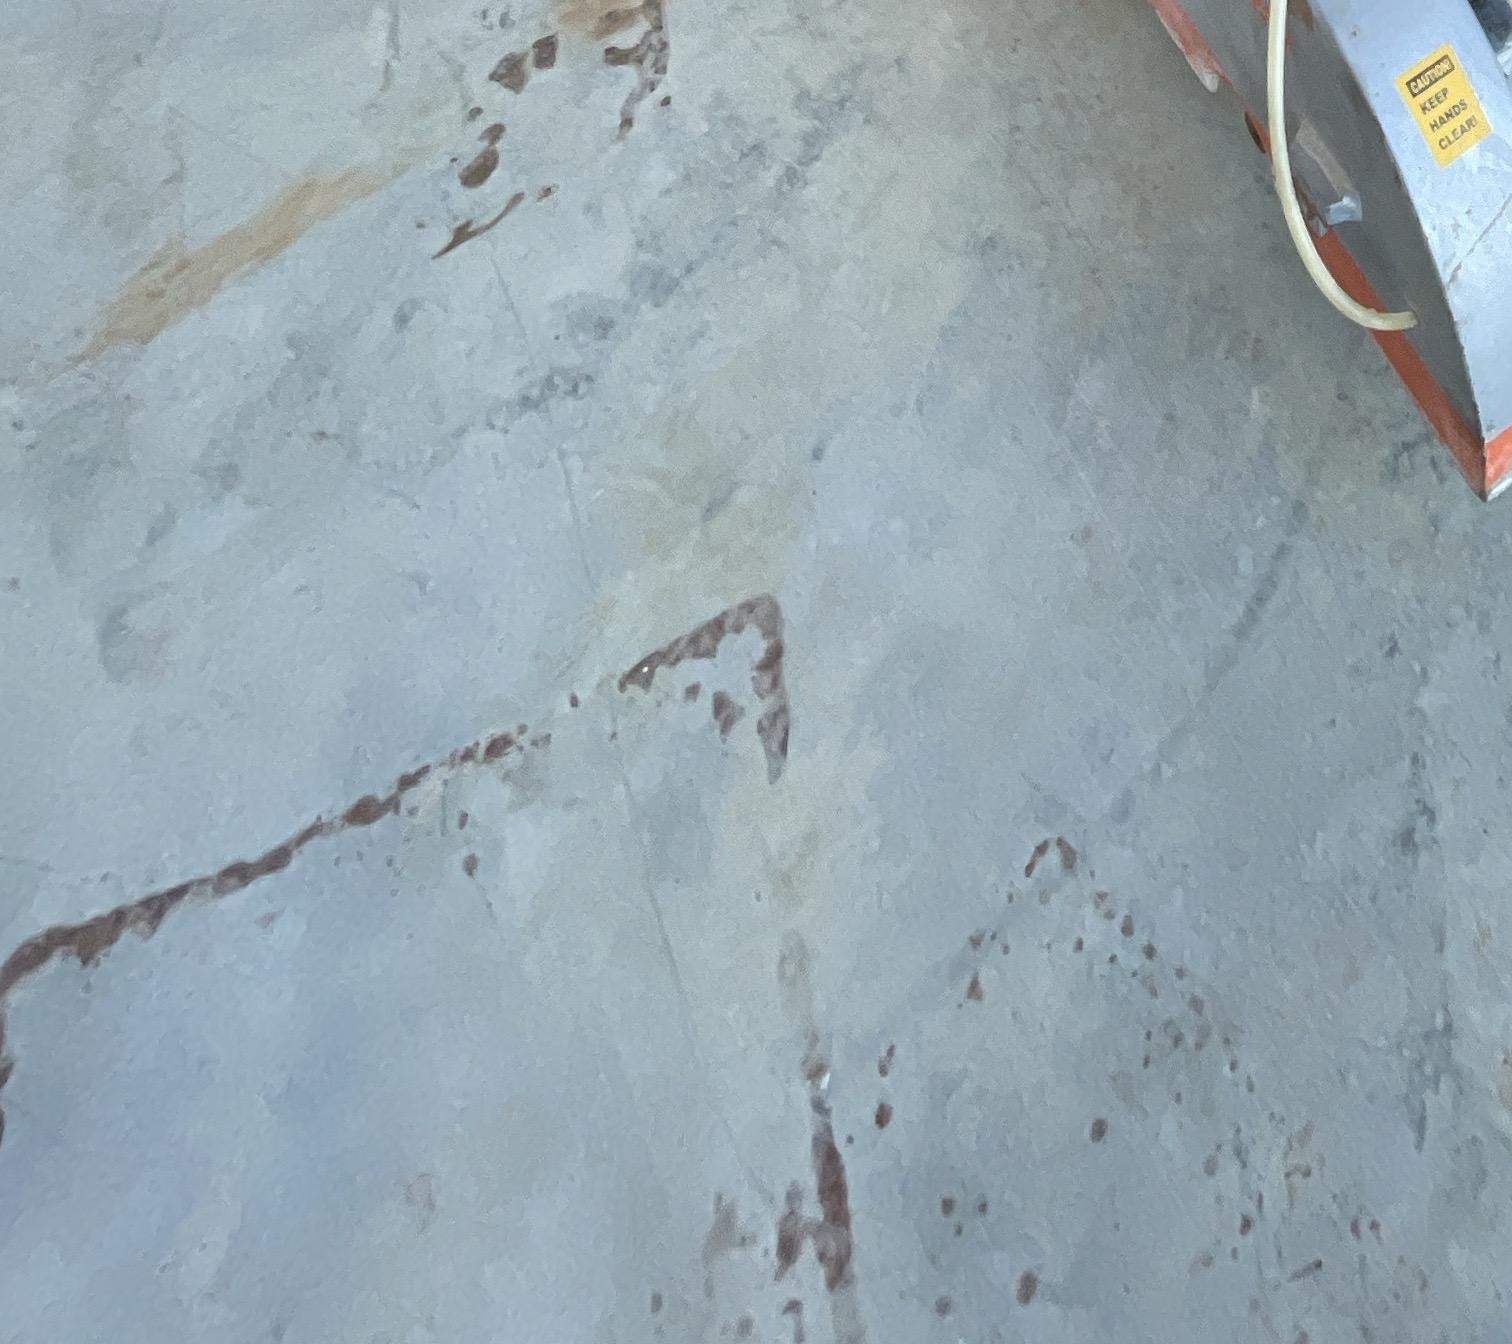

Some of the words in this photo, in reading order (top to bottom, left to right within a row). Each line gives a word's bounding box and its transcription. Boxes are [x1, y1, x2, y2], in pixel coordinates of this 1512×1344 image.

[1409, 57, 1452, 94] CAUTION!
[1419, 87, 1449, 115] KEEP
[1428, 99, 1468, 132] HANDS
